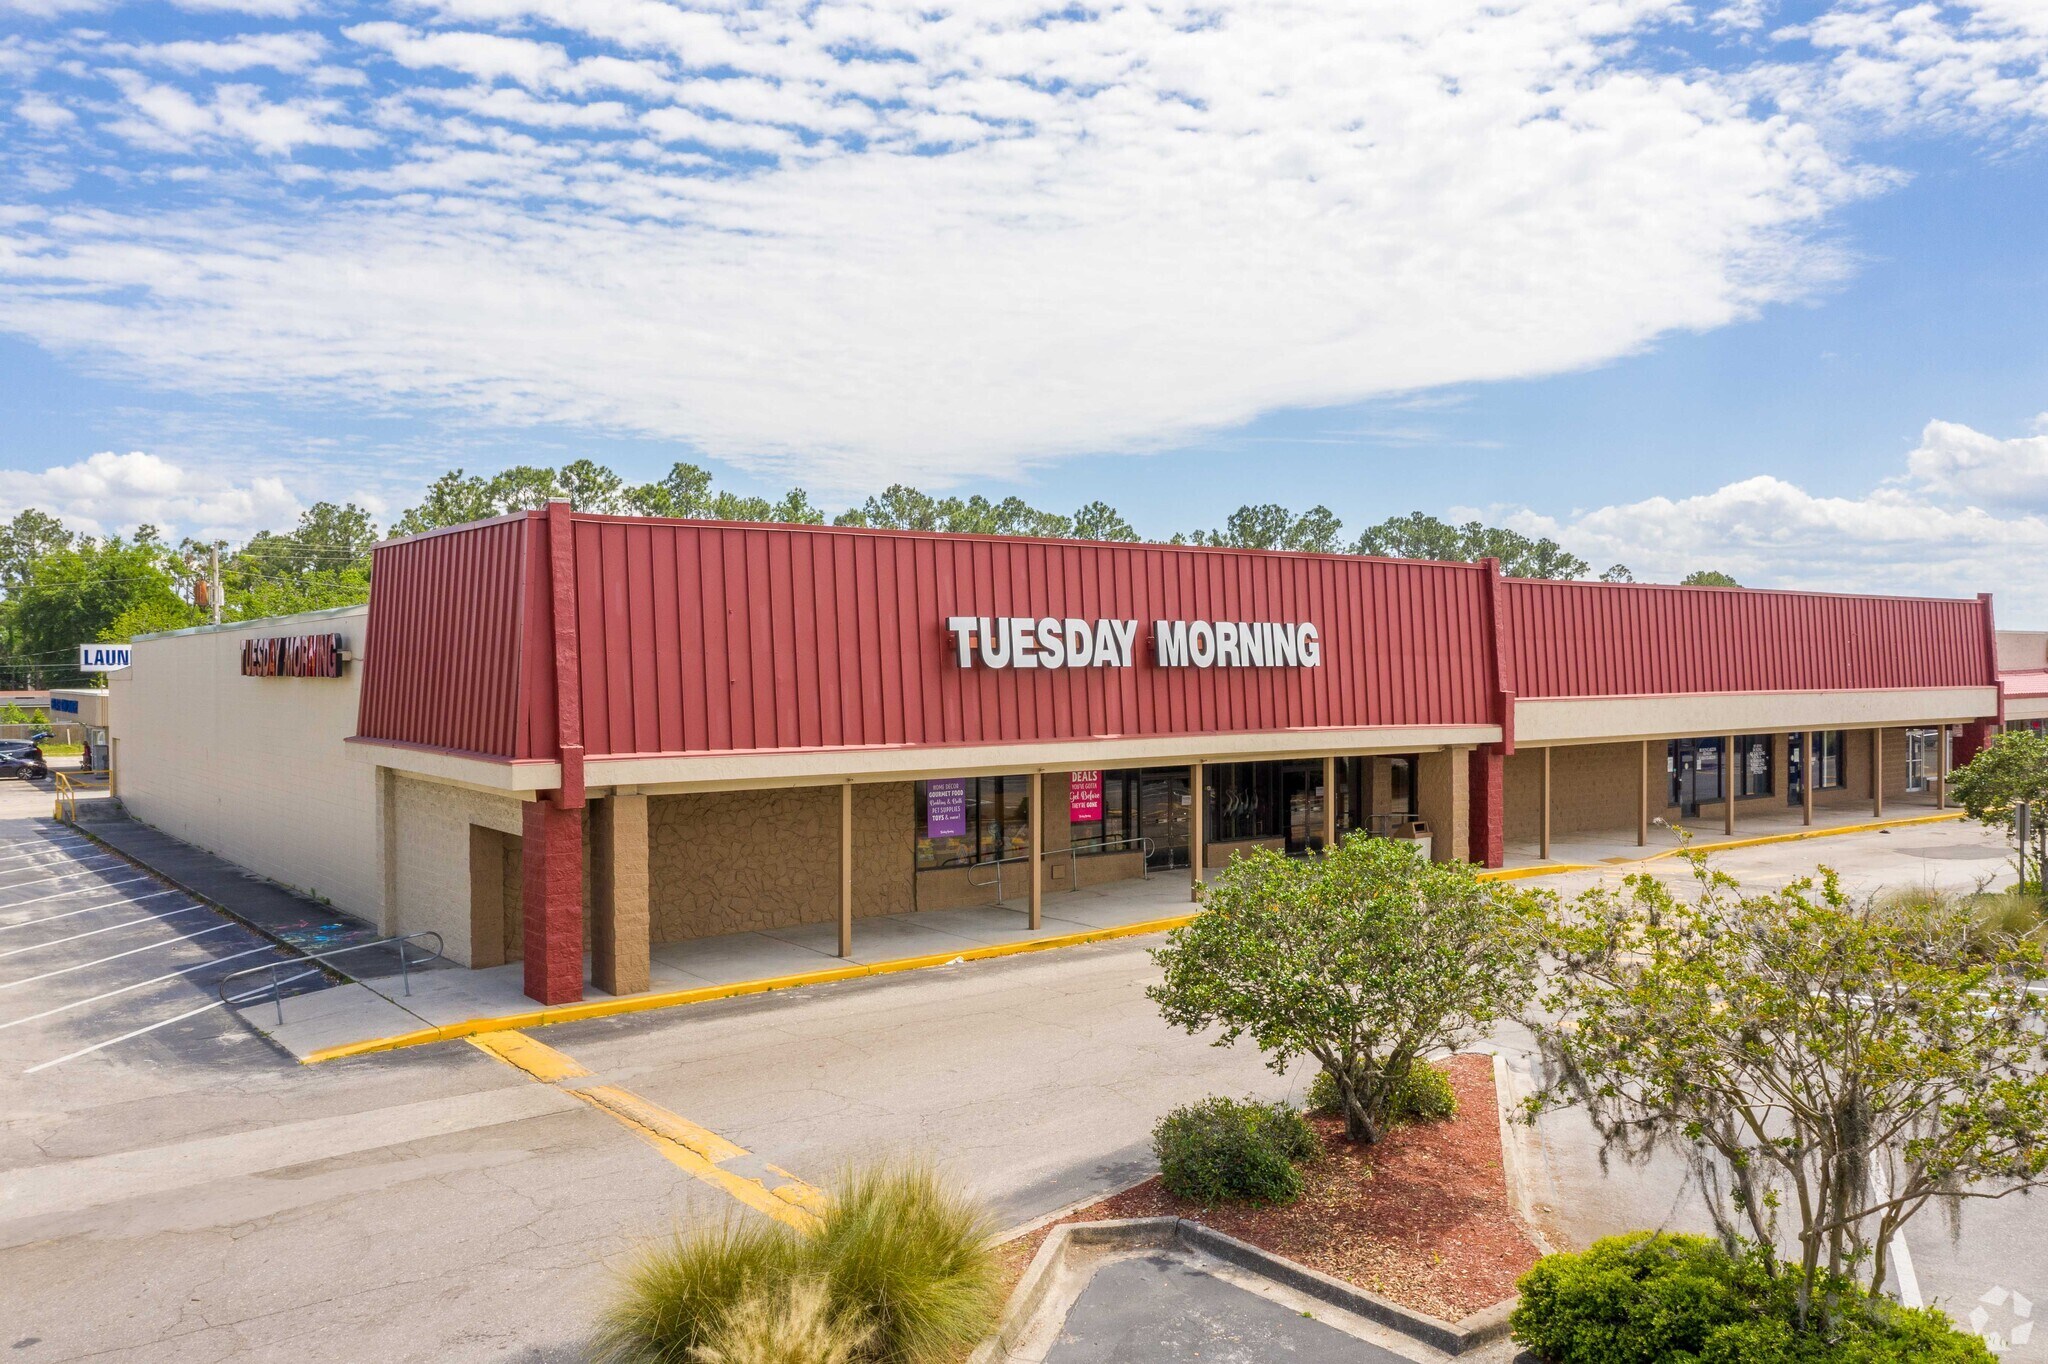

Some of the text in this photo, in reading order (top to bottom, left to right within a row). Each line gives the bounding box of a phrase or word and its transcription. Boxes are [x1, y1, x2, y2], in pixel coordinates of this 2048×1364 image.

[947, 616, 1321, 669] TUESDAY MORNING
[83, 649, 132, 666] LAUN
[240, 633, 339, 678] TUESDAY MORNING
[1072, 771, 1097, 782] DEALS
[1081, 790, 1099, 800] Before
[940, 805, 961, 813] SUPPLIES
